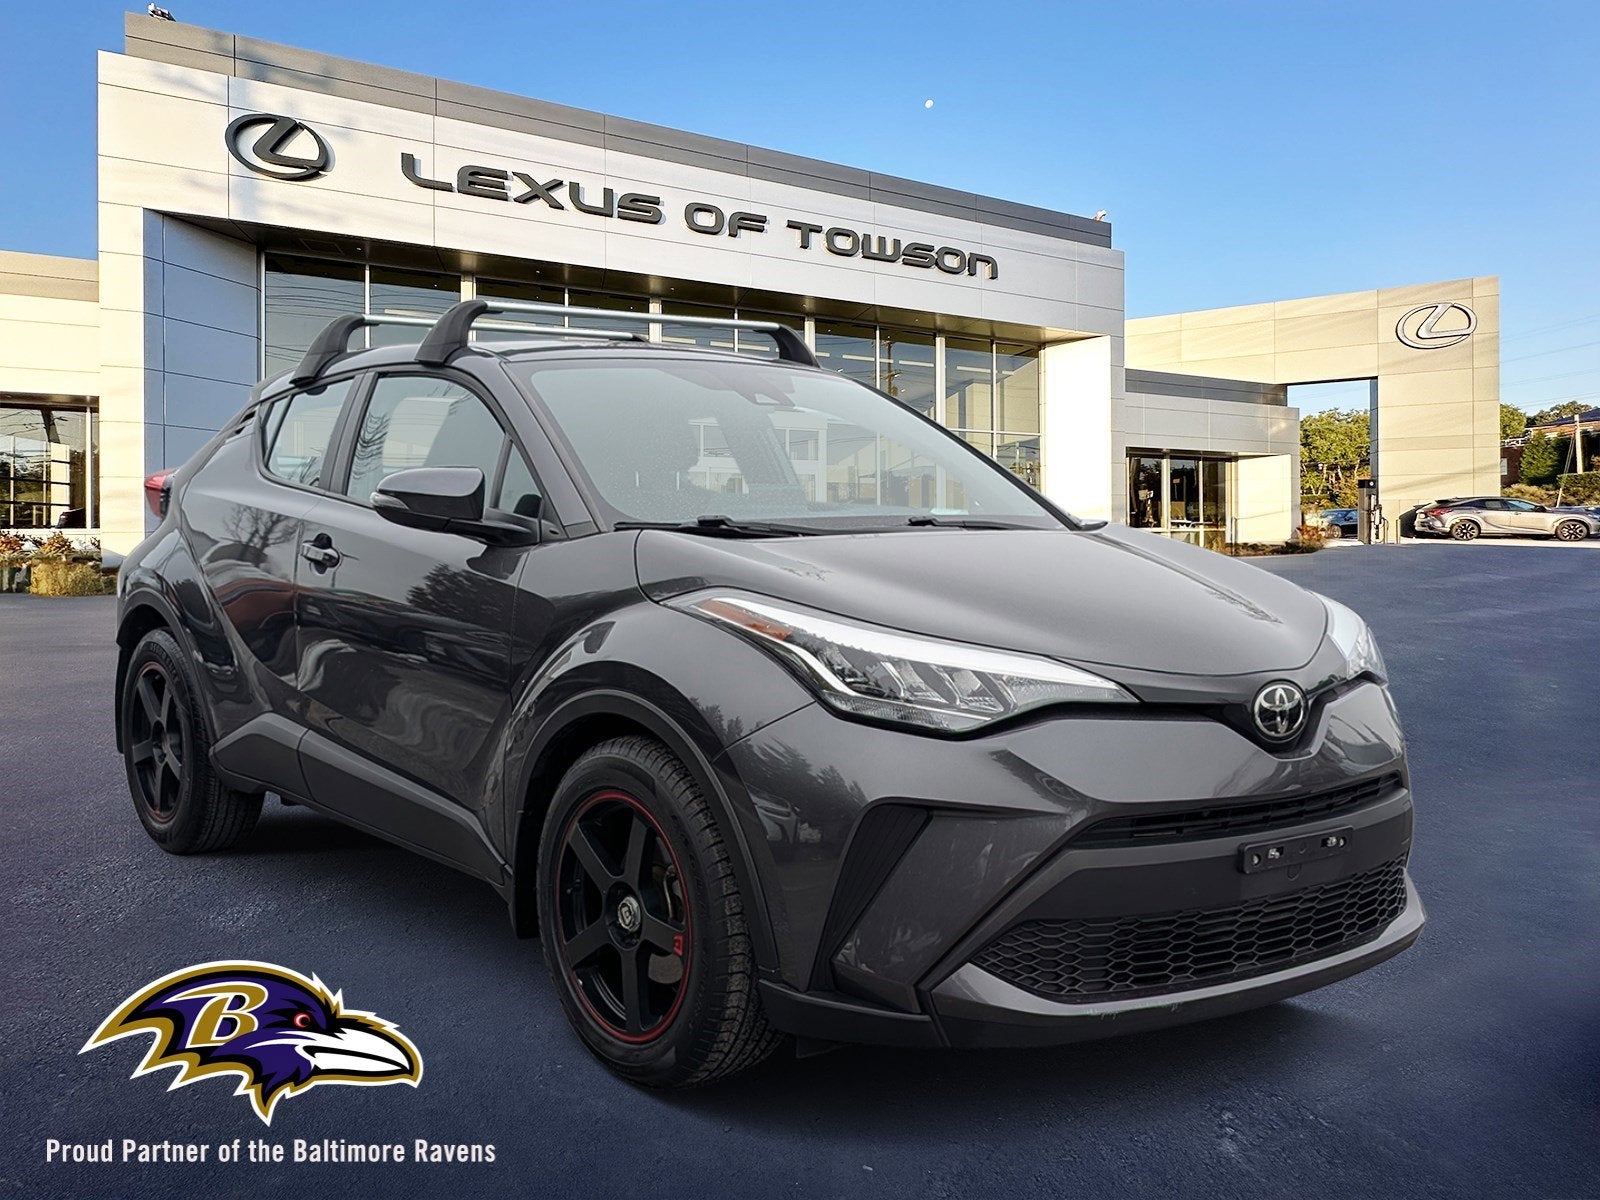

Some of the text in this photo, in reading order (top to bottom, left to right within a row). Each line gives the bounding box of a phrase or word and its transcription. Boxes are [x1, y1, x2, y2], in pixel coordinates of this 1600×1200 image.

[400, 152, 999, 281] LEXUS OF TOWSON
